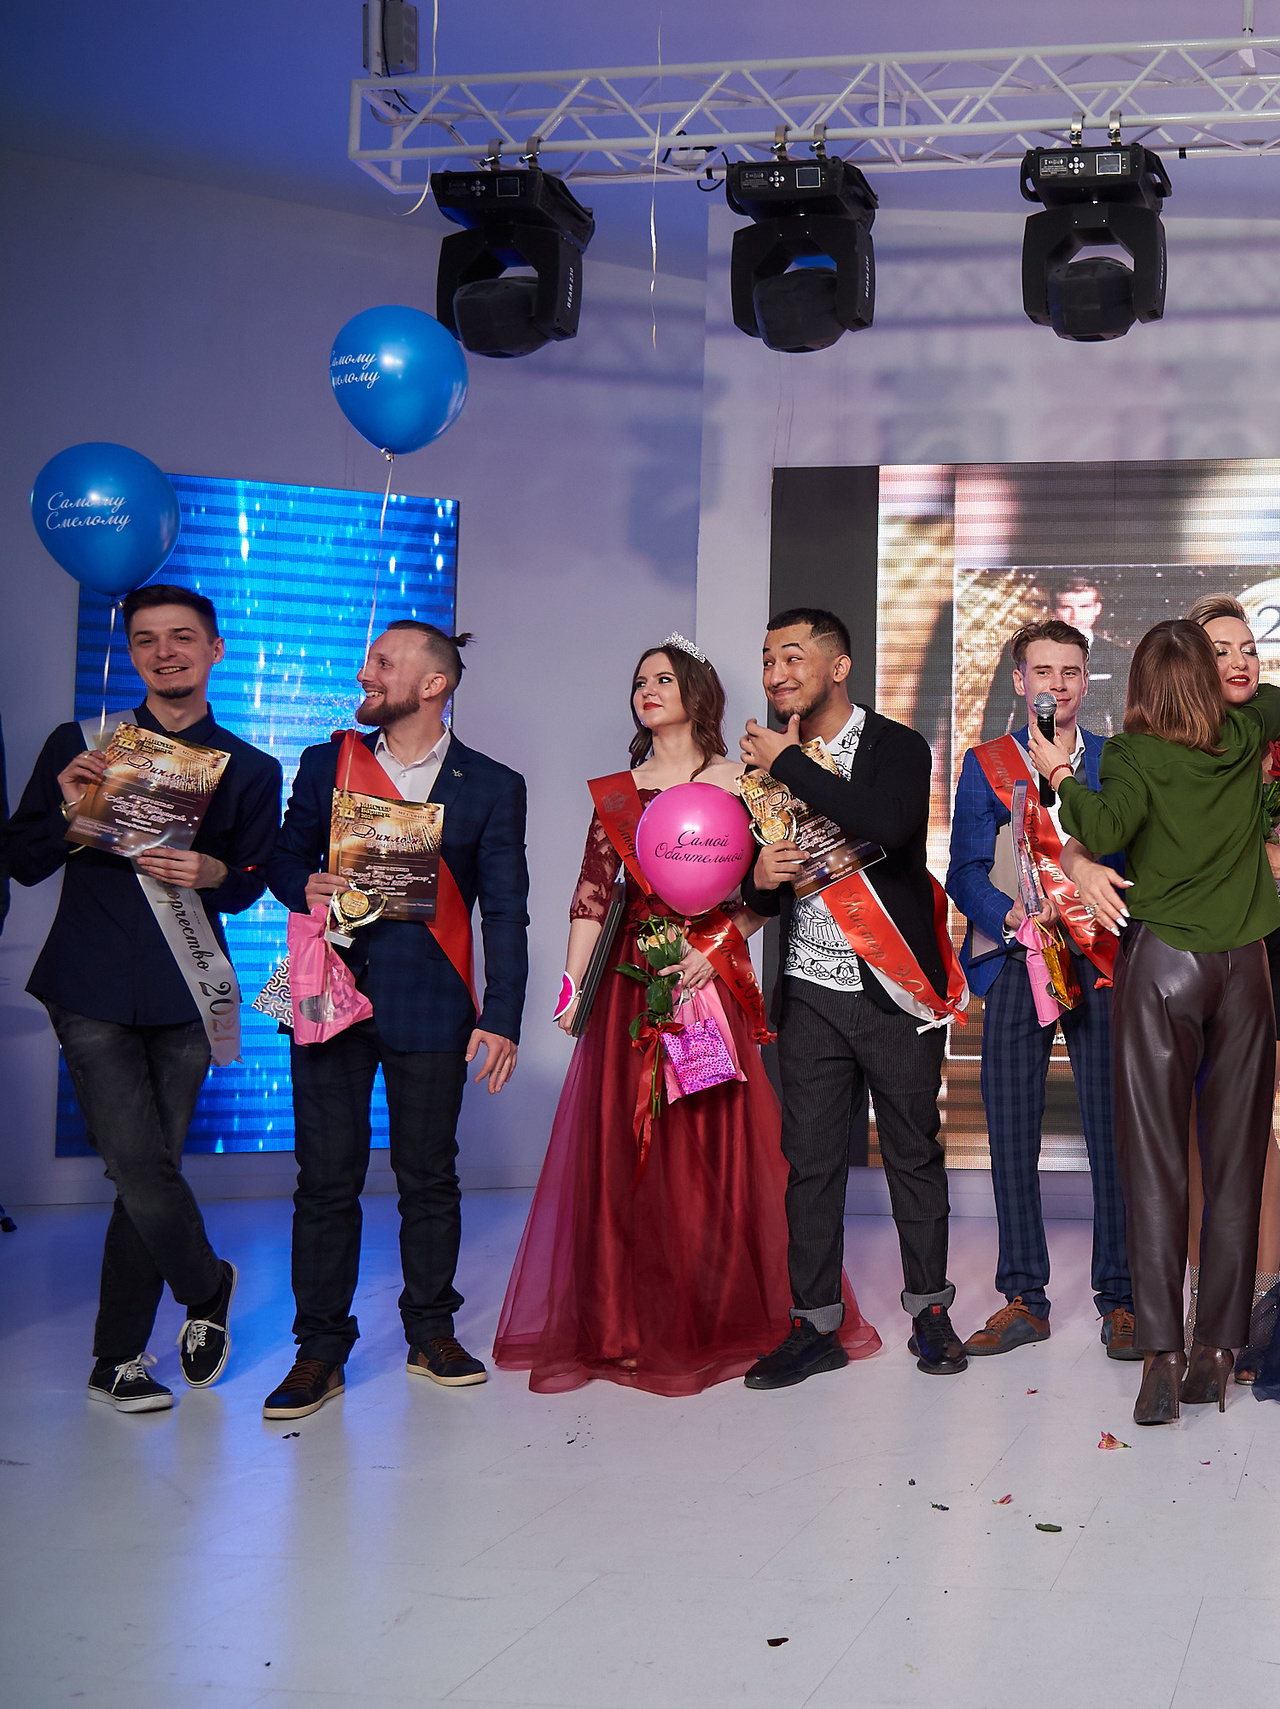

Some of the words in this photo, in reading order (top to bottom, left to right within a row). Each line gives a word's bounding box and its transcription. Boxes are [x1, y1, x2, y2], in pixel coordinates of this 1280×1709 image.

[46, 511, 131, 532] Смелому
[125, 755, 195, 784] Диплом
[350, 823, 420, 845] Диплом
[677, 829, 730, 848] Самой
[654, 841, 745, 865] Обаятельной
[835, 886, 887, 963] Мистер
[197, 981, 236, 1042] 2021
